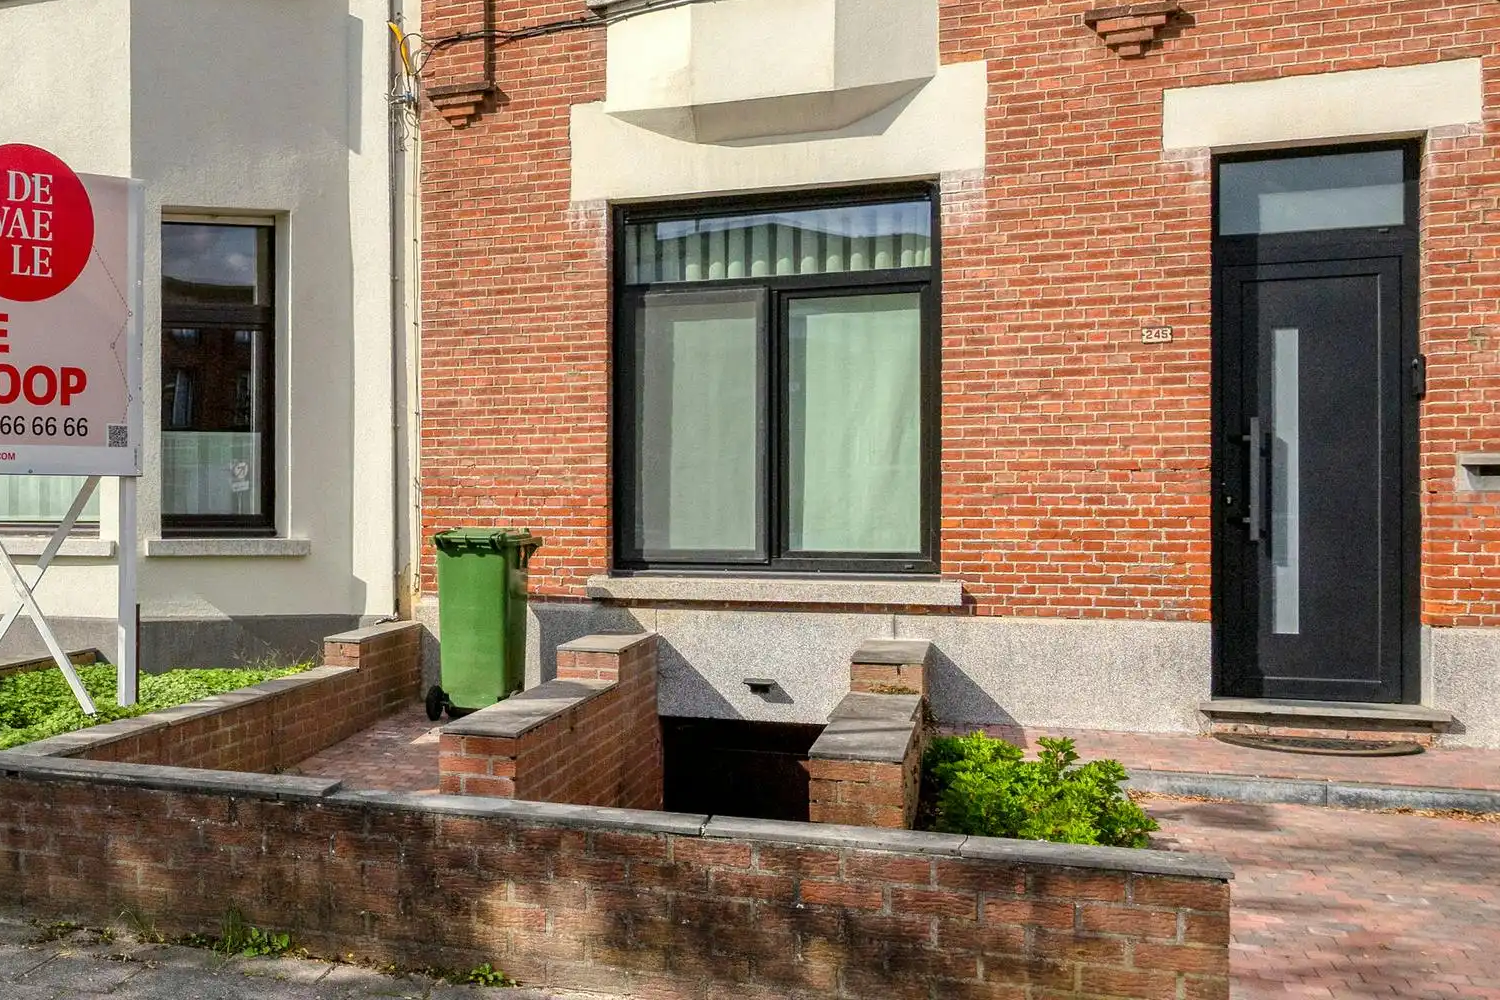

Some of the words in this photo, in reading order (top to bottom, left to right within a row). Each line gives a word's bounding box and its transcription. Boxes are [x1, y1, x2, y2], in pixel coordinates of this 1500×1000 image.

[7, 170, 53, 205] DE
[11, 244, 53, 277] LE
[1145, 329, 1169, 340] 245
[32, 416, 57, 436] 66
[63, 417, 88, 437] 66
